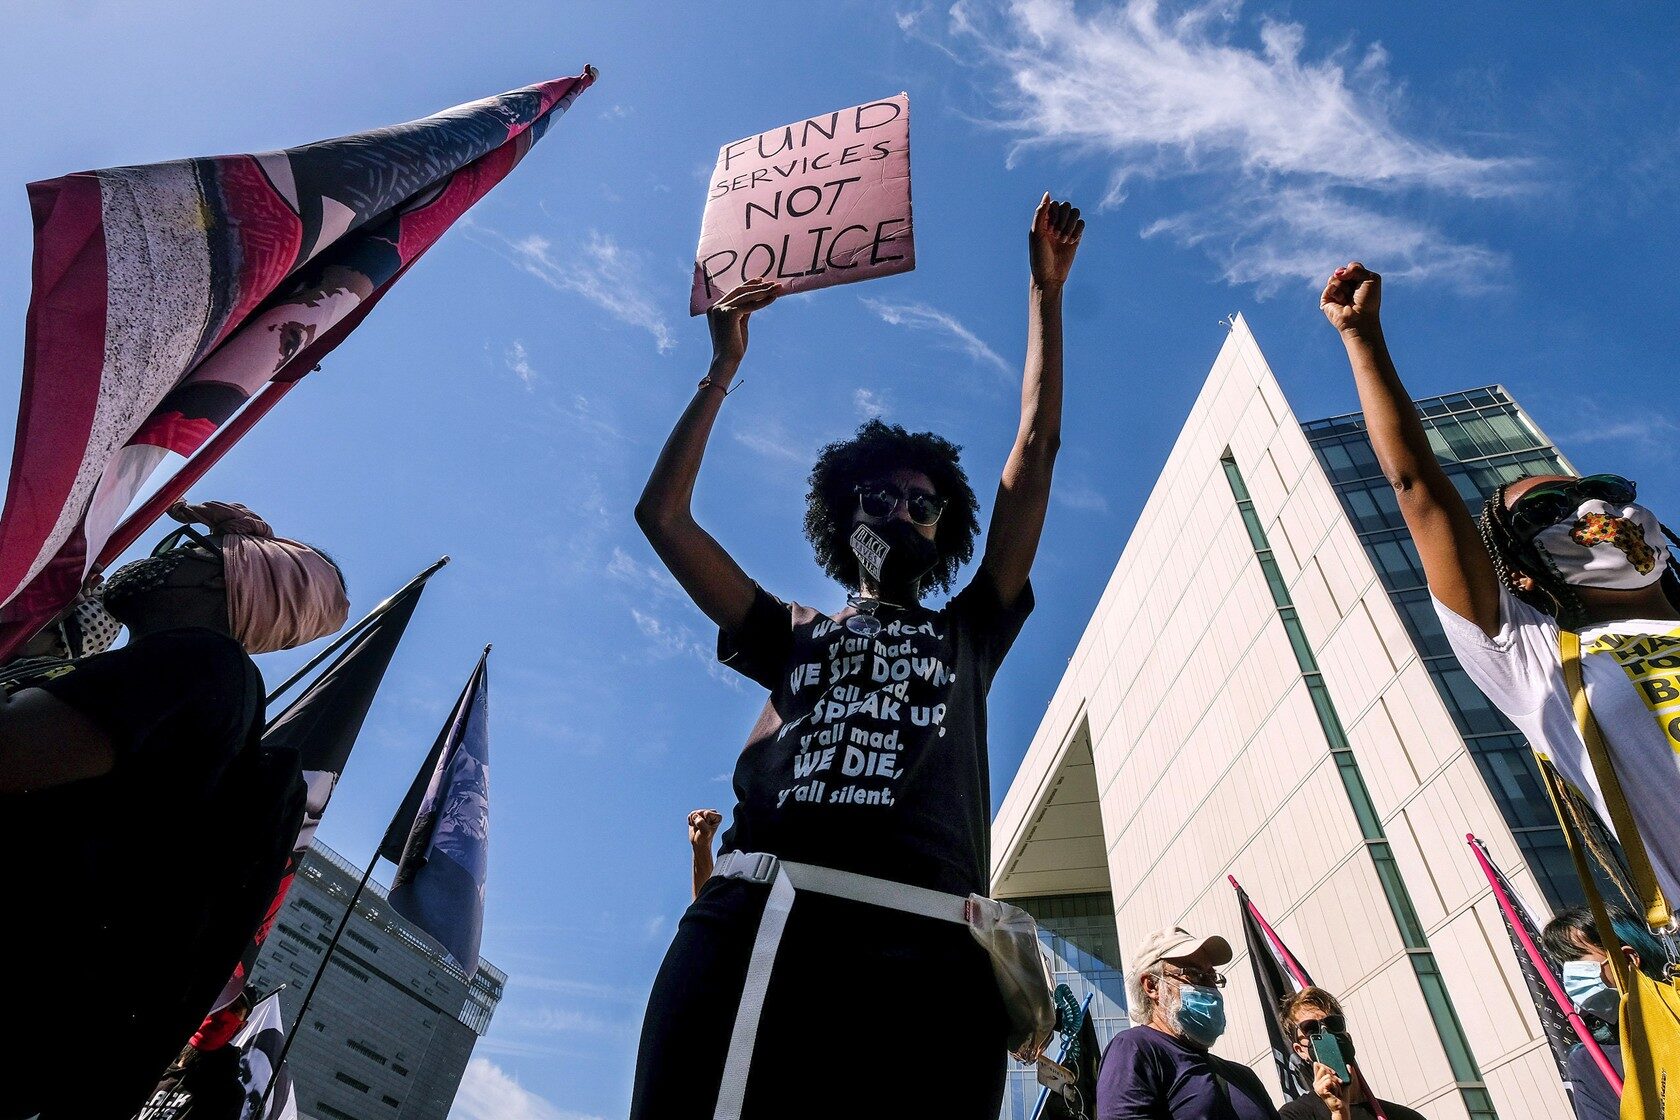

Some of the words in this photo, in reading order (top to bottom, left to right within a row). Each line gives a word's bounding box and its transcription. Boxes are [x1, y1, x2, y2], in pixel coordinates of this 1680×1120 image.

[725, 102, 901, 170] FUND
[711, 140, 891, 198] SERVICES
[745, 176, 861, 229] NOT
[702, 218, 905, 299] POLICE
[856, 529, 885, 558] BLACK
[829, 636, 868, 660] y'all
[873, 640, 918, 659] mad.
[790, 662, 822, 696] WE
[829, 654, 864, 686] SIT
[1621, 655, 1680, 676] TO
[832, 684, 860, 702] all
[1640, 674, 1680, 706] B
[810, 693, 901, 725] SPEAK
[800, 722, 846, 755] y'all
[850, 726, 904, 752] mad.
[793, 745, 836, 780] WE
[841, 744, 904, 780] DIE,
[776, 780, 826, 810] y'all
